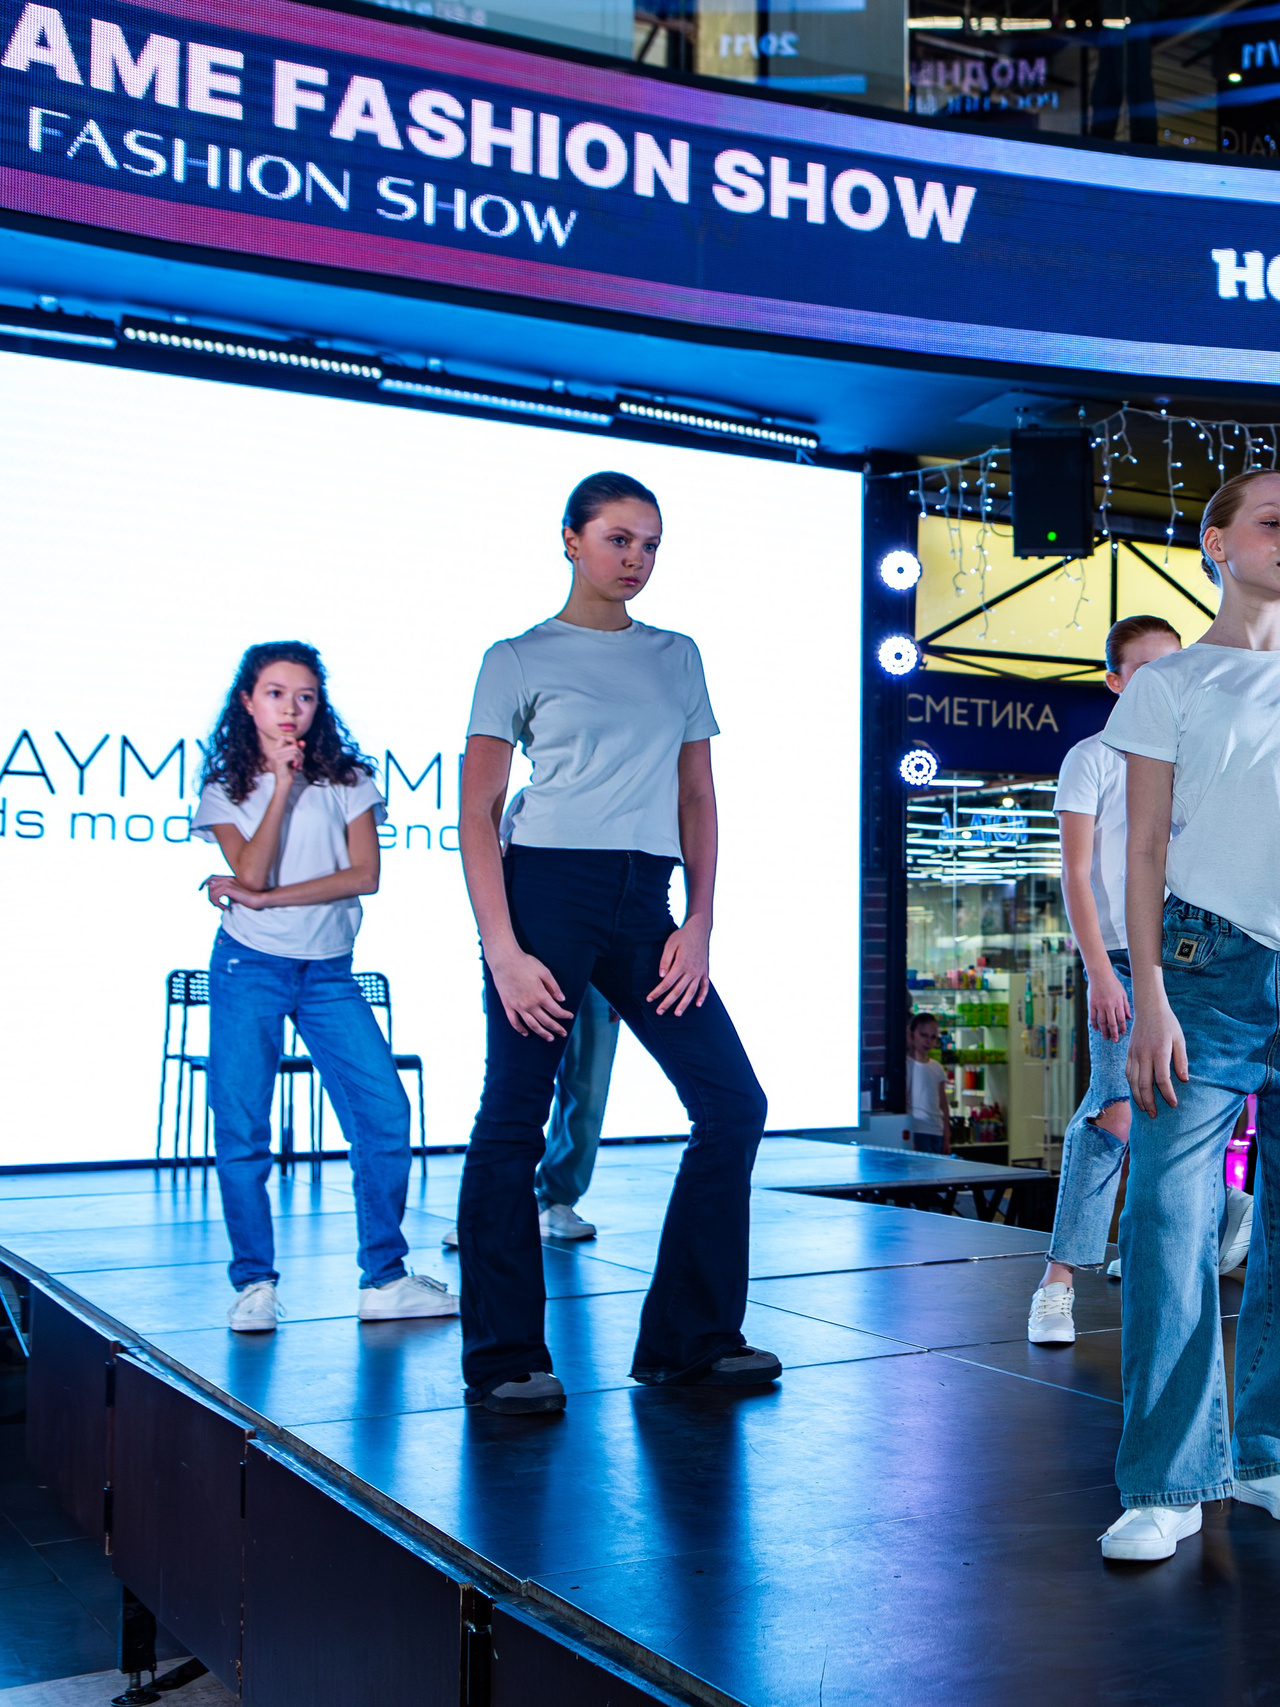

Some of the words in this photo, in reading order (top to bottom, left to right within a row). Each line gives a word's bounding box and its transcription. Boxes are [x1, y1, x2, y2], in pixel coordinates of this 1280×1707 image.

[2, 3, 245, 120] AME
[273, 60, 690, 204] FASHION
[712, 149, 977, 244] SHOW
[28, 105, 350, 211] FASHION
[375, 176, 577, 248] SHOW
[70, 804, 192, 843] mod
